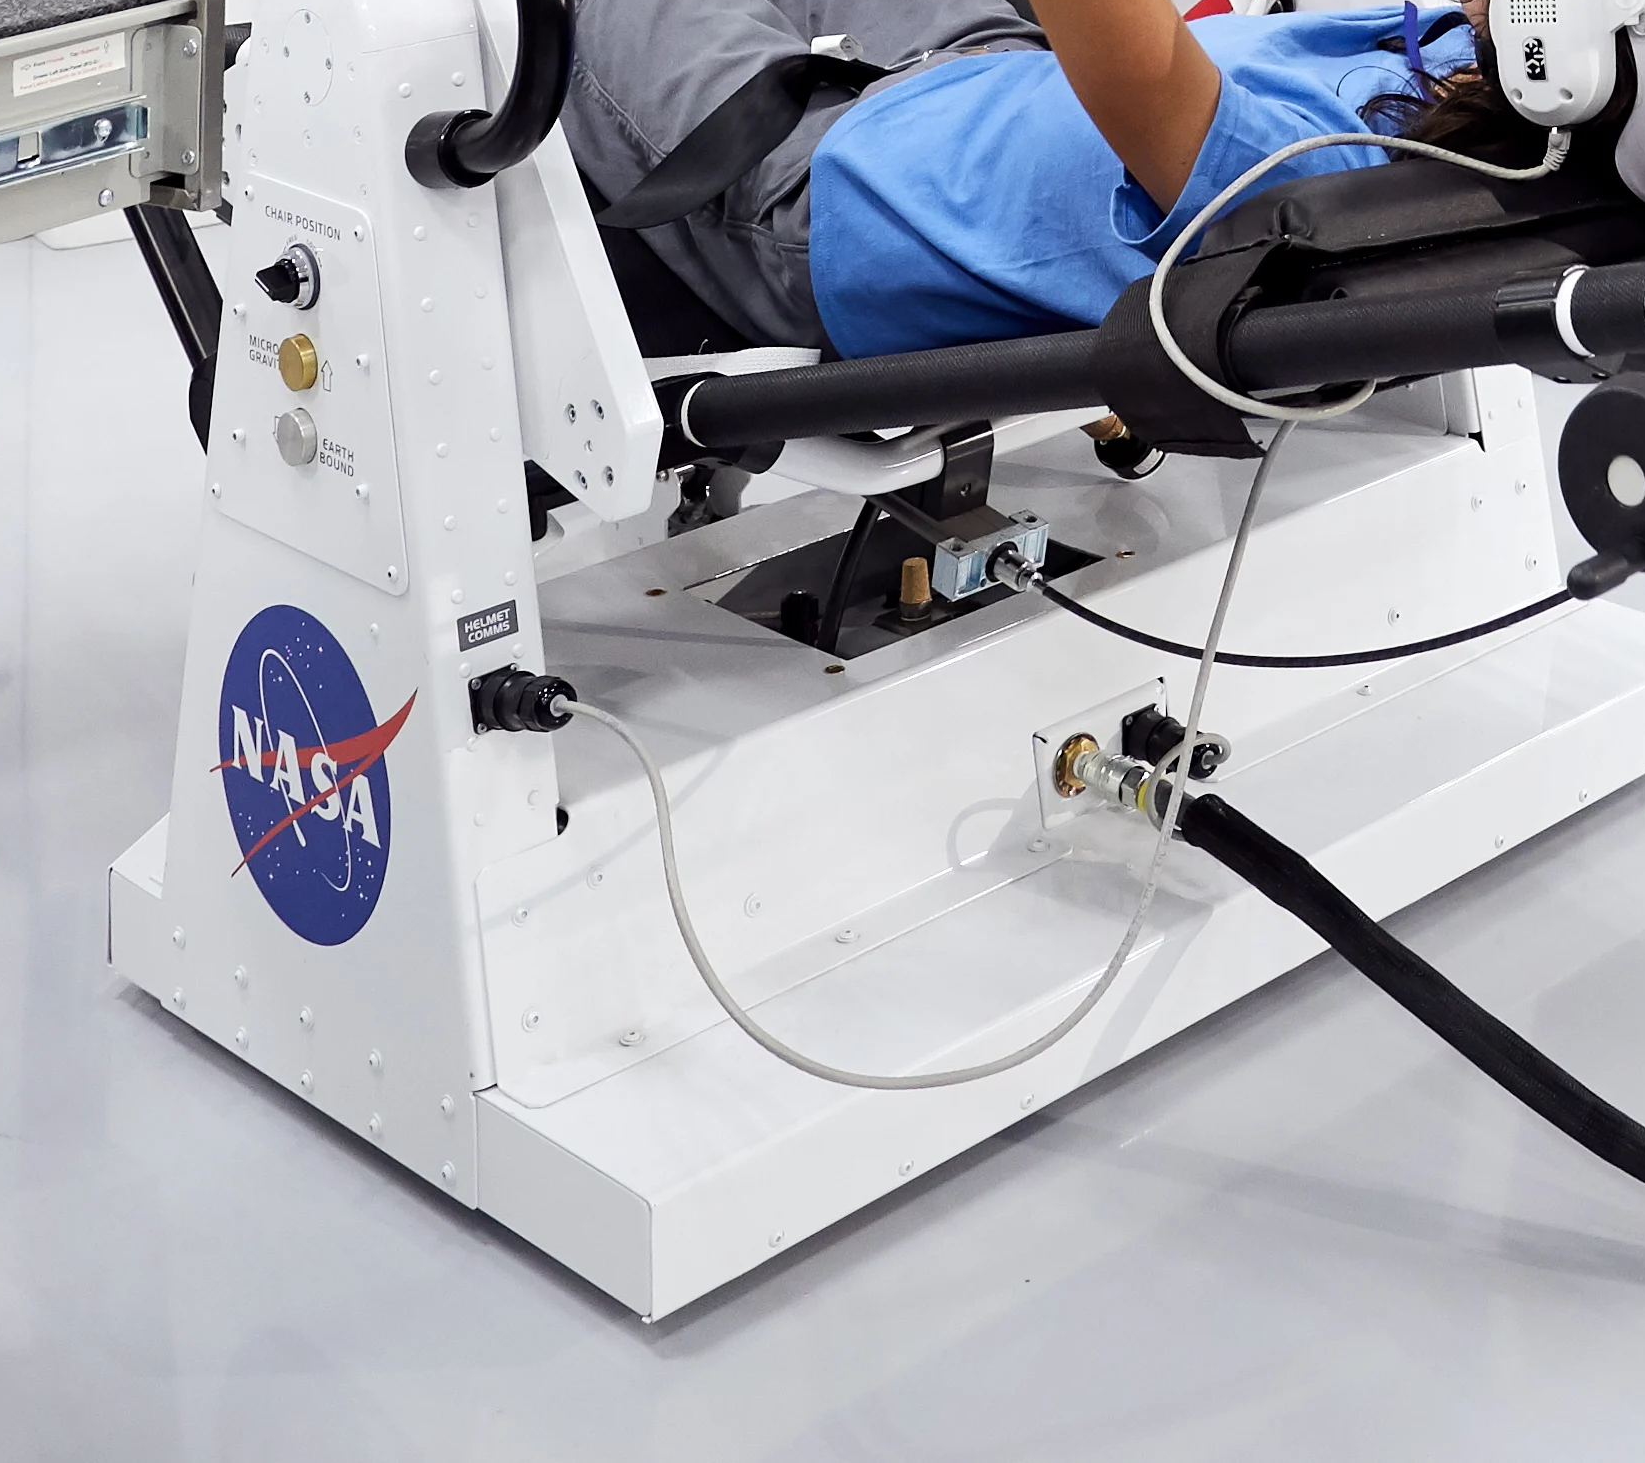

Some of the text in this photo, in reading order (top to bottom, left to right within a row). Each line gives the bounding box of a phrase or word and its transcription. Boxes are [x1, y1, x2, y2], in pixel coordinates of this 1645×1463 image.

[265, 204, 341, 241] CHAIR POSITION
[249, 334, 279, 356] MICRO
[249, 349, 281, 370] GRAVI
[322, 438, 354, 463] EARTH
[319, 451, 354, 477] BOUND
[464, 607, 511, 634] HELMET
[468, 620, 511, 644] COMMS
[231, 704, 382, 850] NASA
